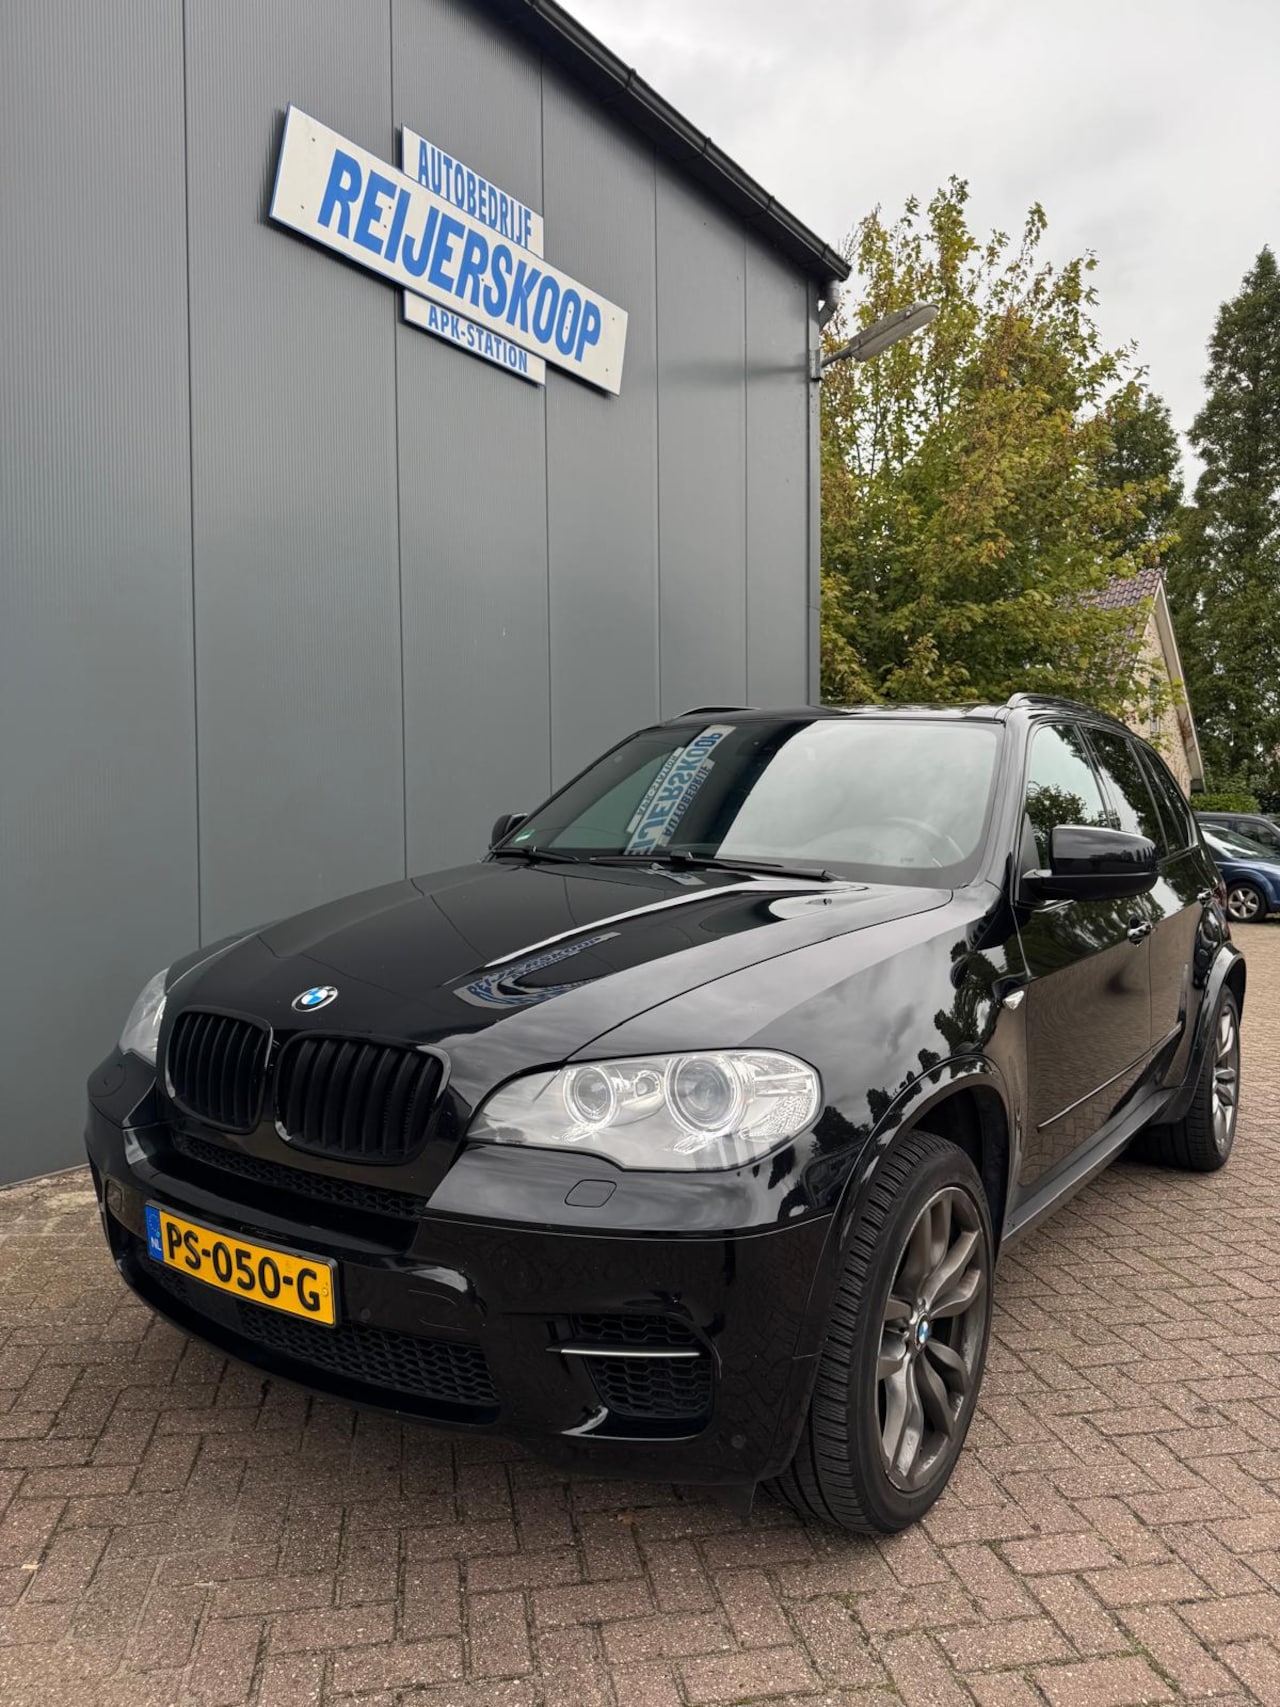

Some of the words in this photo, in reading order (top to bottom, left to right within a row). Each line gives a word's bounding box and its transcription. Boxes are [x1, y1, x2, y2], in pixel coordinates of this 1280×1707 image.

[418, 139, 532, 250] AUTOBEDRIJF
[317, 149, 601, 362] REIJERSKOOP
[428, 305, 528, 373] APK-STATION
[150, 1236, 162, 1251] NL
[166, 1222, 320, 1312] PS-050-G
